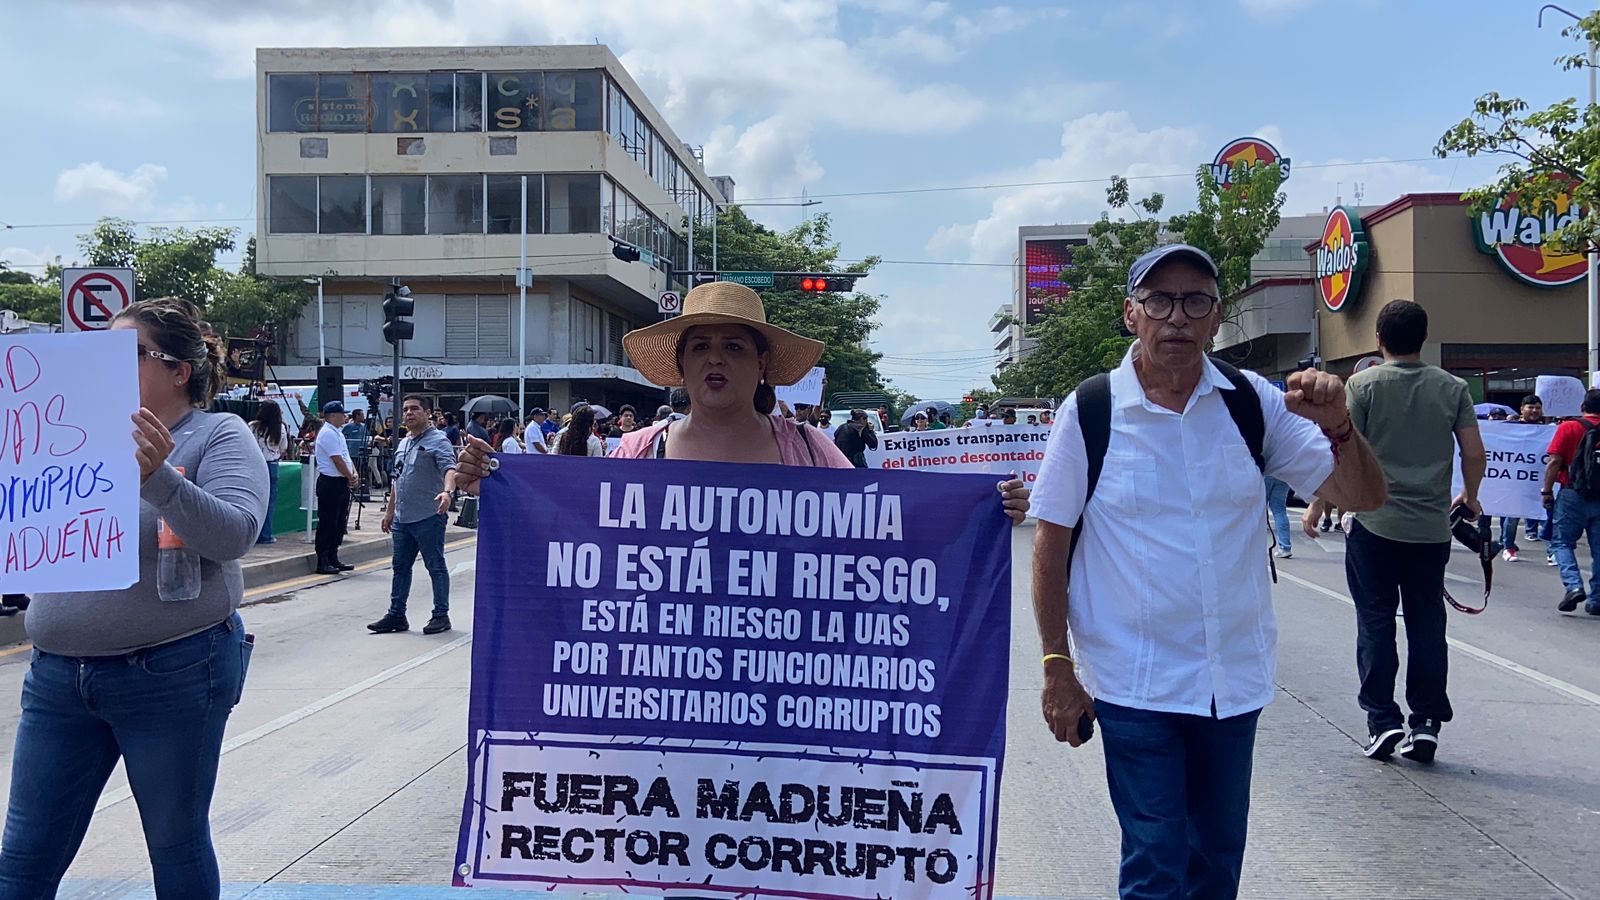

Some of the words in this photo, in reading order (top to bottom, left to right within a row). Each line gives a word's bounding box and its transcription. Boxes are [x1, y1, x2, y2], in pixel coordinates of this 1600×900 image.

[1209, 157, 1290, 184] Wa's
[745, 276, 772, 284] ESCOBEDO
[1316, 233, 1358, 279] Waldo's
[882, 457, 904, 469] del
[908, 455, 956, 468] dinero
[960, 450, 1044, 464] descontado
[884, 436, 950, 452] Exigimos
[1483, 468, 1512, 480] DA
[1516, 470, 1539, 482] DE
[599, 482, 646, 529] LA
[661, 482, 903, 541] AUTONOMÍA
[0, 508, 125, 574] ADUEÑA
[547, 542, 602, 589] NO
[616, 537, 713, 594] ESTÁ
[728, 550, 777, 597] EN
[793, 553, 950, 612] RIESGO,
[582, 594, 648, 633] ESTÁ
[659, 603, 693, 636] EN
[704, 606, 801, 641] RIESGO
[812, 611, 844, 643] LA
[855, 613, 910, 647] UAS
[553, 641, 608, 675] POR
[619, 644, 723, 680] TANTOS
[733, 649, 936, 693] FUNCIONARIOS
[543, 684, 767, 726] UNIVERSITARIOS
[777, 695, 942, 738] CORRUPTOS
[501, 771, 681, 819] FUERA
[696, 778, 963, 835] MADUEÑA
[501, 824, 691, 867] RECTOR
[704, 833, 959, 884] CORRUPTO
